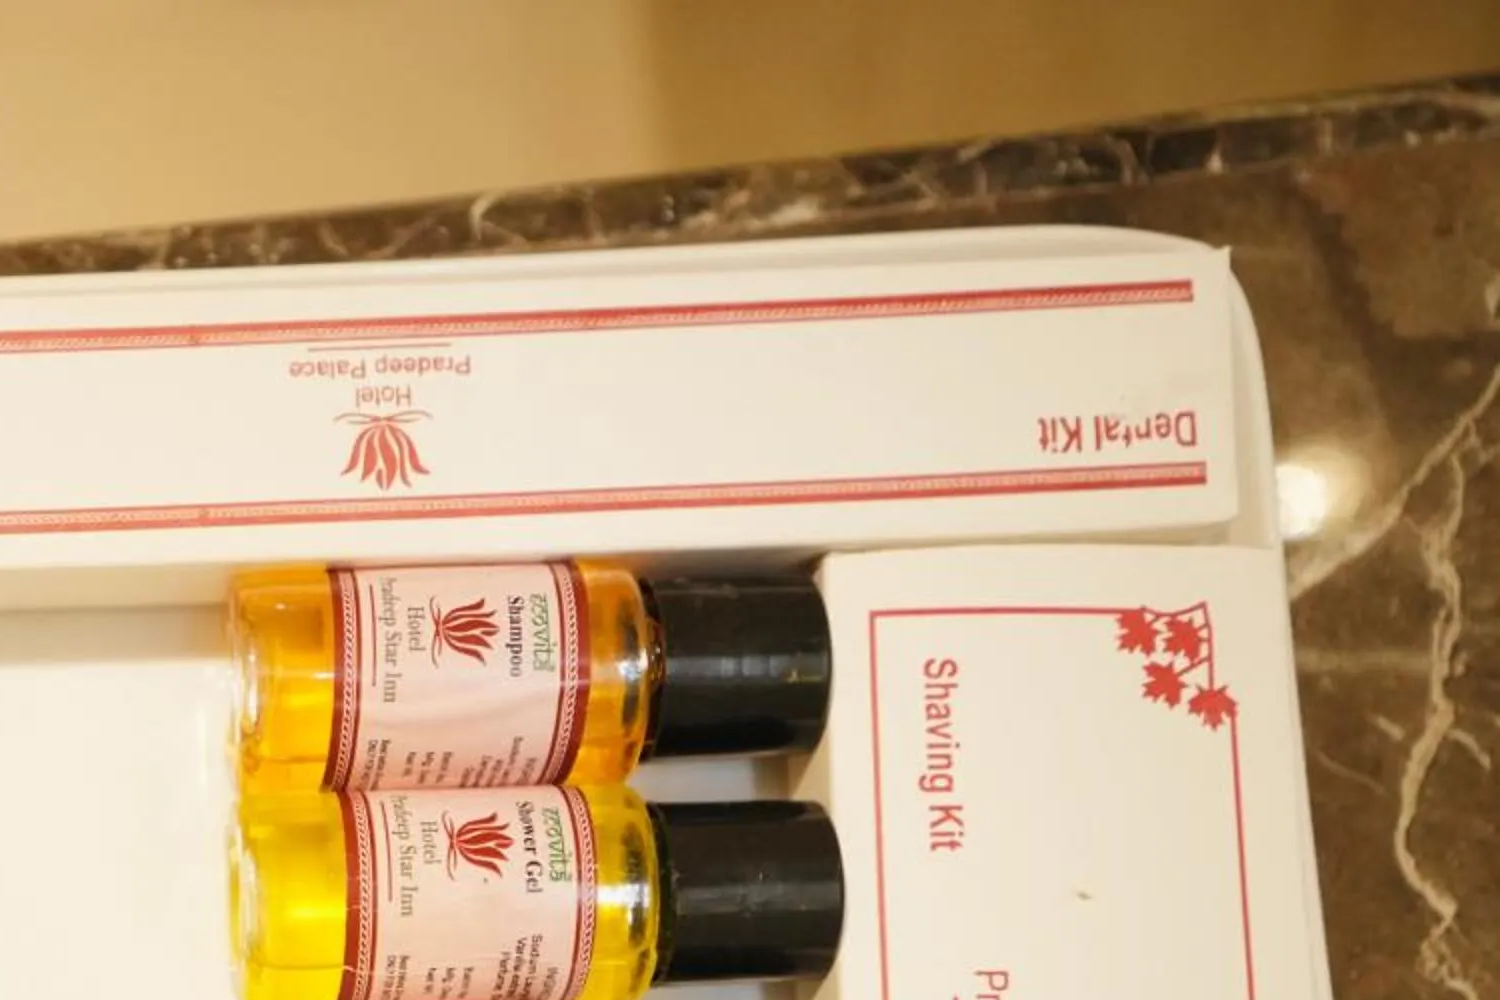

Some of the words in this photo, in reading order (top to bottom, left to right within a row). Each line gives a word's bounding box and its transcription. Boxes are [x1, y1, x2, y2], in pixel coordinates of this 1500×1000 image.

[289, 359, 366, 380] Palace
[374, 355, 472, 377] Pradeep
[355, 385, 412, 407] Hotel
[1037, 416, 1082, 453] Kit
[407, 606, 425, 652] Hotel
[506, 596, 525, 677] Shampoo
[383, 631, 402, 667] Star
[382, 673, 402, 704] Inn
[918, 658, 960, 793] Shaving
[420, 821, 440, 864] Hotel
[515, 801, 537, 856] Shower
[928, 805, 965, 852] Kit
[399, 845, 417, 880] Star
[524, 861, 544, 893] Gel
[399, 886, 418, 917] Inn
